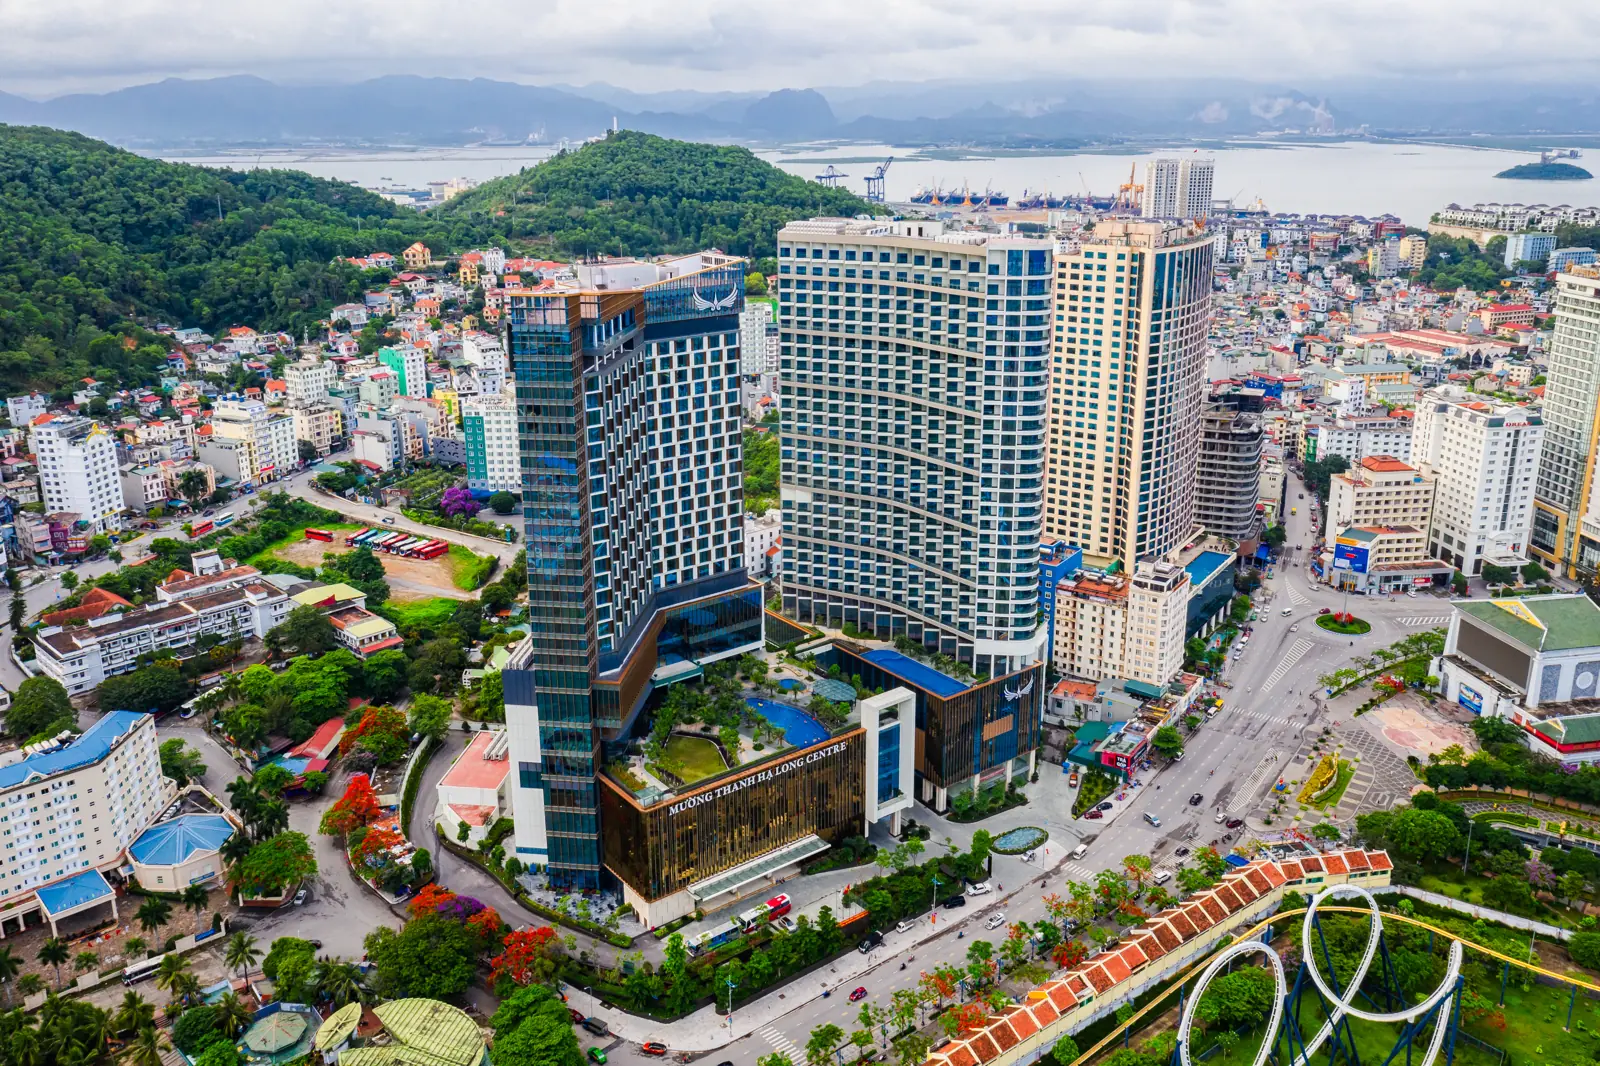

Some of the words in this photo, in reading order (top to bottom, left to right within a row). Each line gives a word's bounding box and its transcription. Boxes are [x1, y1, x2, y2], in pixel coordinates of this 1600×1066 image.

[714, 777, 756, 798] THANH
[757, 770, 774, 783] HẠ
[775, 759, 804, 776] LONG
[806, 741, 847, 764] CENTRE
